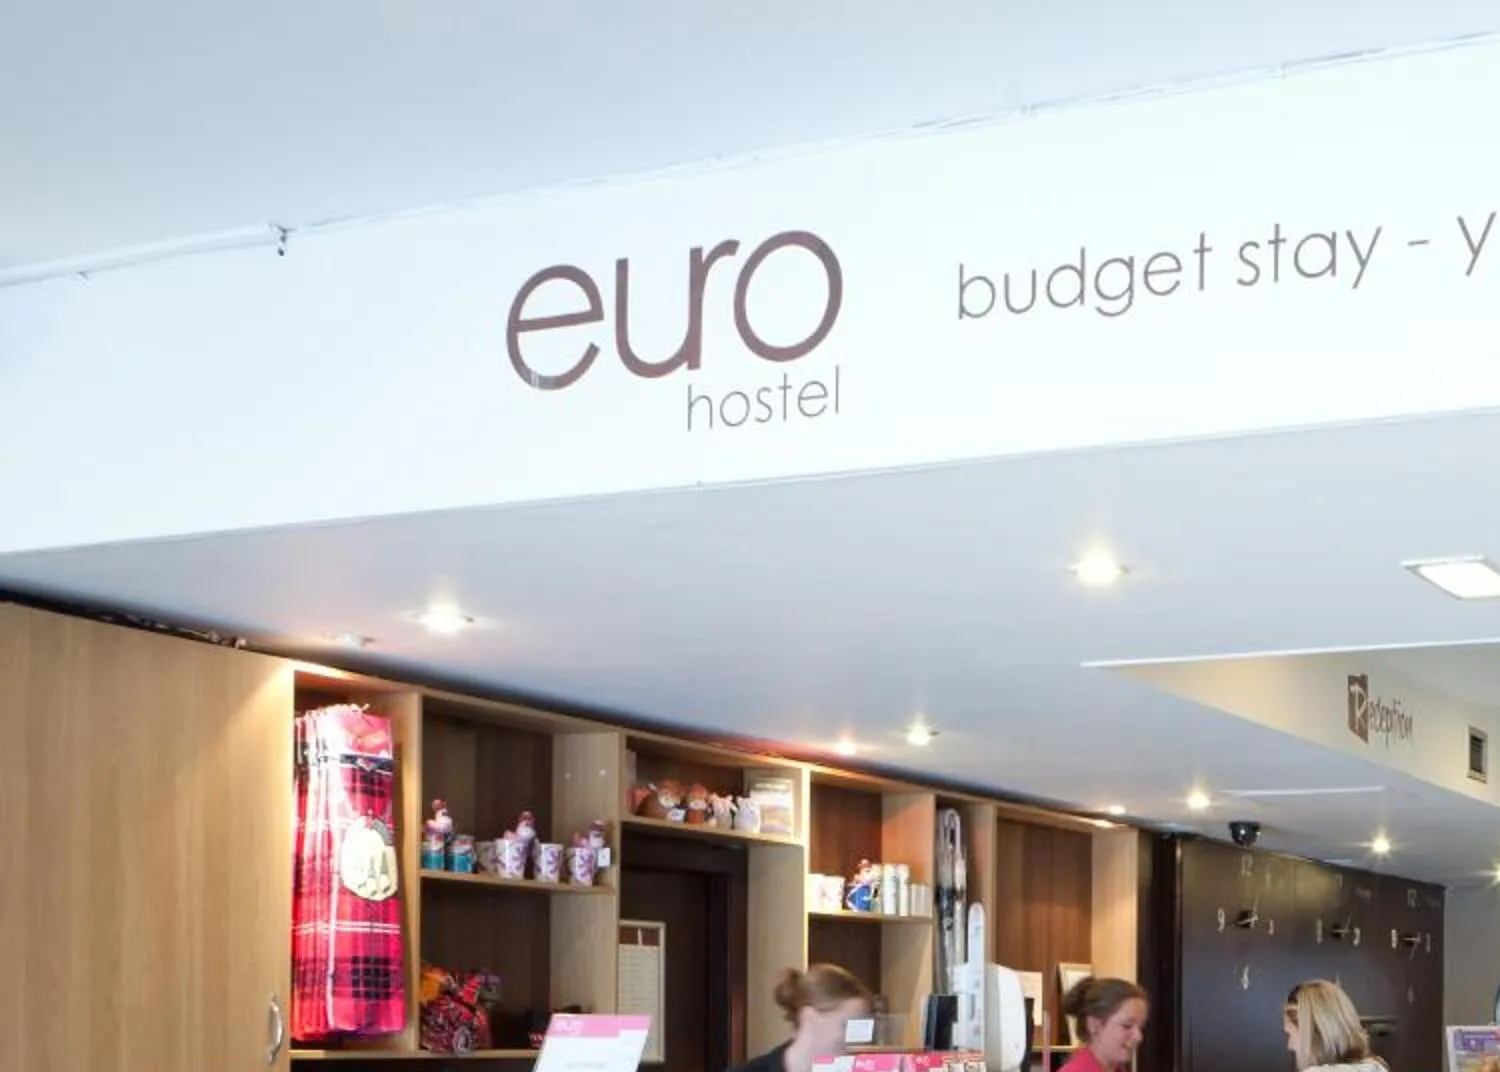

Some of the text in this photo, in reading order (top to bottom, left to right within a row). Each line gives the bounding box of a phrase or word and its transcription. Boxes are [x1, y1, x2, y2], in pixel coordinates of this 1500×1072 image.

[505, 229, 844, 392] euro
[957, 231, 1213, 318] budget
[1236, 224, 1383, 290] stay
[686, 364, 841, 433] hostel
[1347, 673, 1413, 749] Reception
